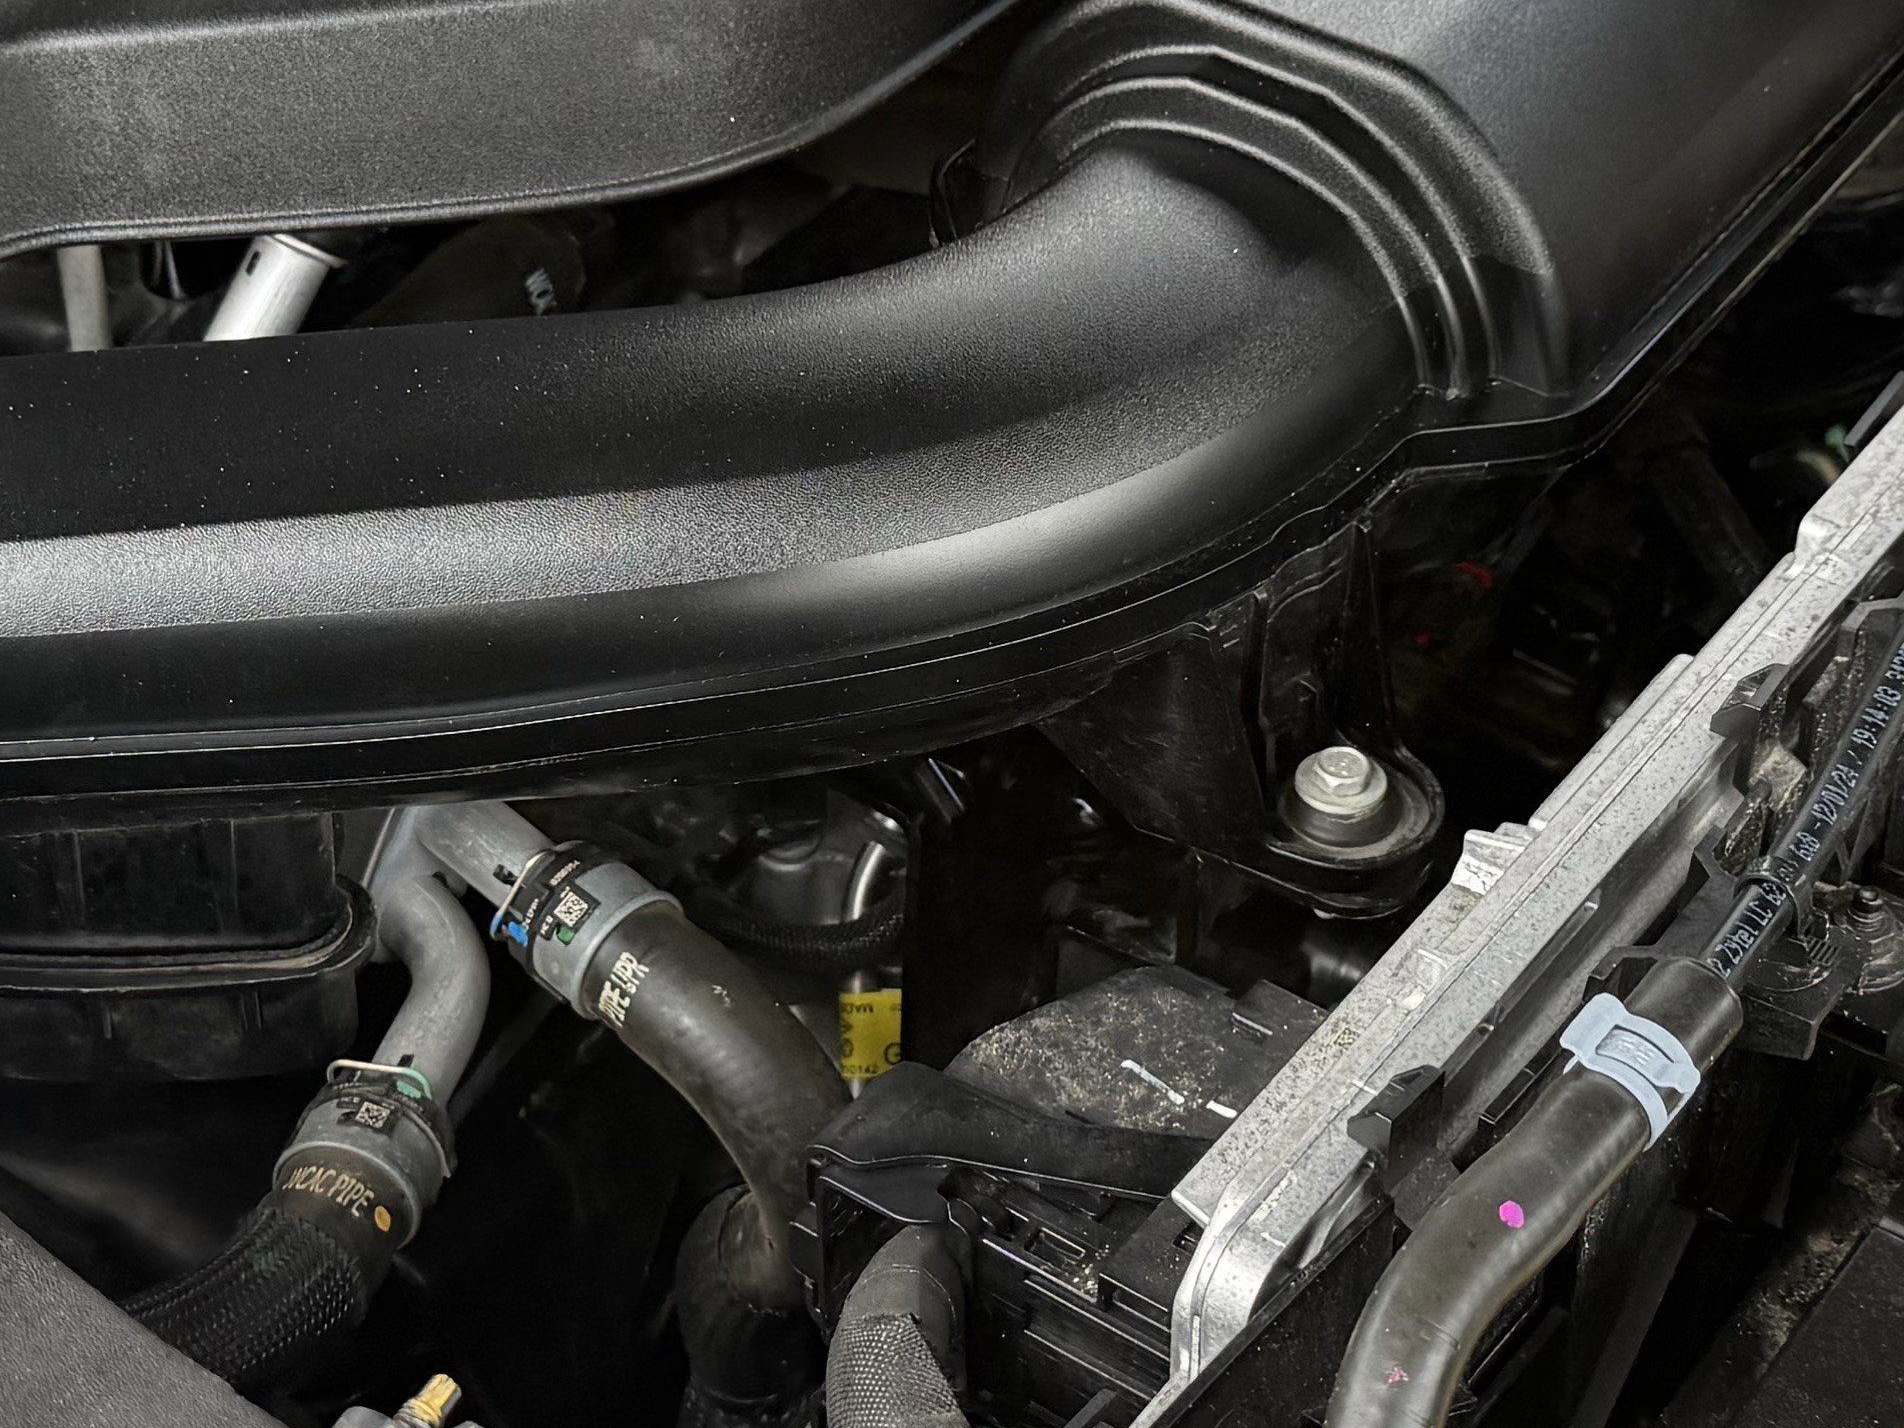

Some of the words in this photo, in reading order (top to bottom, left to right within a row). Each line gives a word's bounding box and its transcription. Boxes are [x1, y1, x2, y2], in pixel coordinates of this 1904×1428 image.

[1718, 921, 1755, 961] Zytel
[1851, 685, 1901, 747] 19:14:03
[328, 1174, 374, 1217] PIPE
